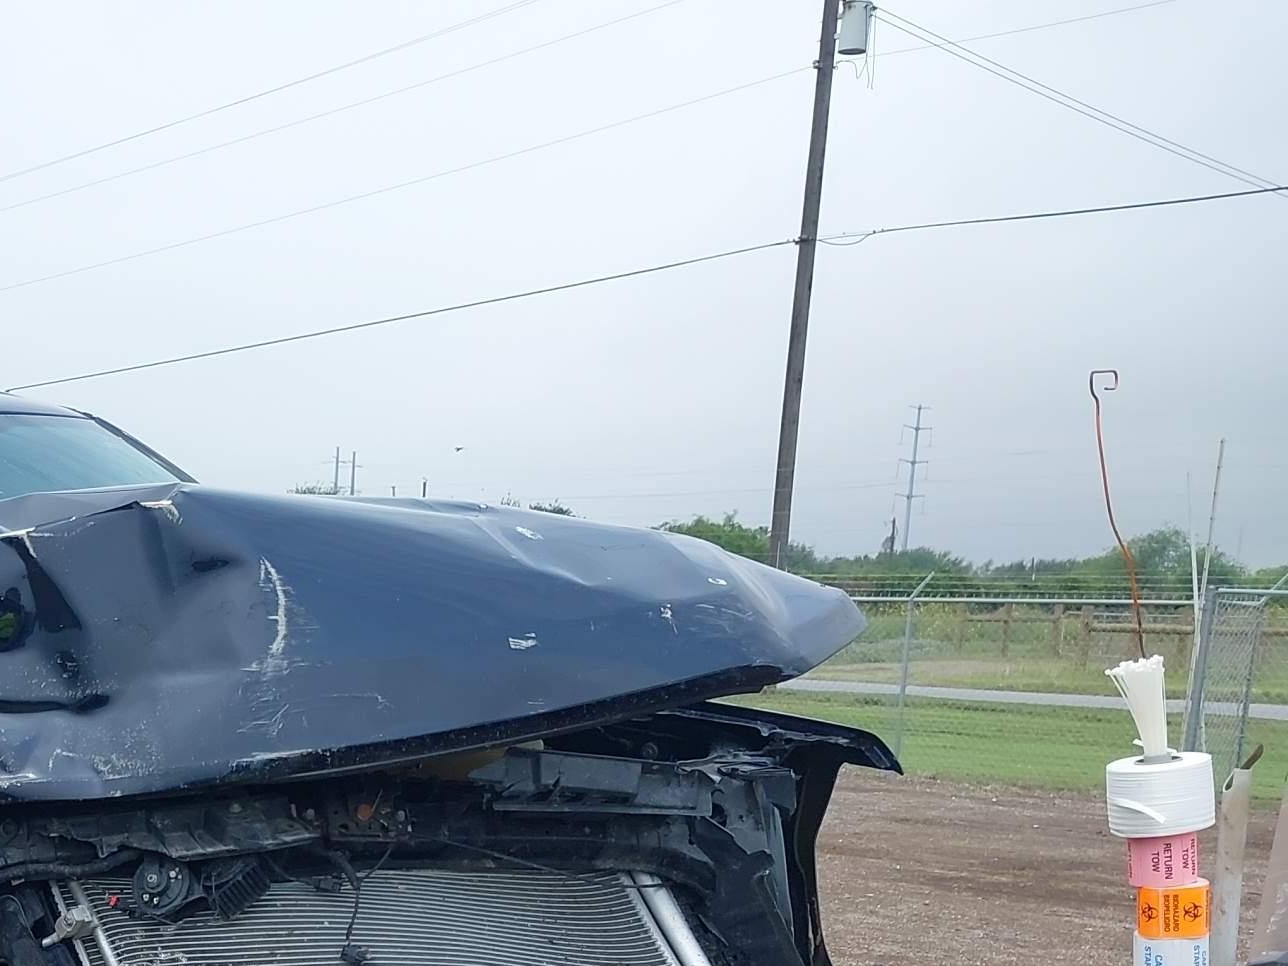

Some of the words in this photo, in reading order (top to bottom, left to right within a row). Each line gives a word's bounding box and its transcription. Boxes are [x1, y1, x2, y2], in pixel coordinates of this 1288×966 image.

[1151, 851, 1161, 873] TOW
[1163, 843, 1173, 880] RETURN
[1182, 848, 1190, 869] TOW
[1163, 894, 1171, 933] BIOPELIGRO
[1172, 894, 1180, 932] BIOHAZARD
